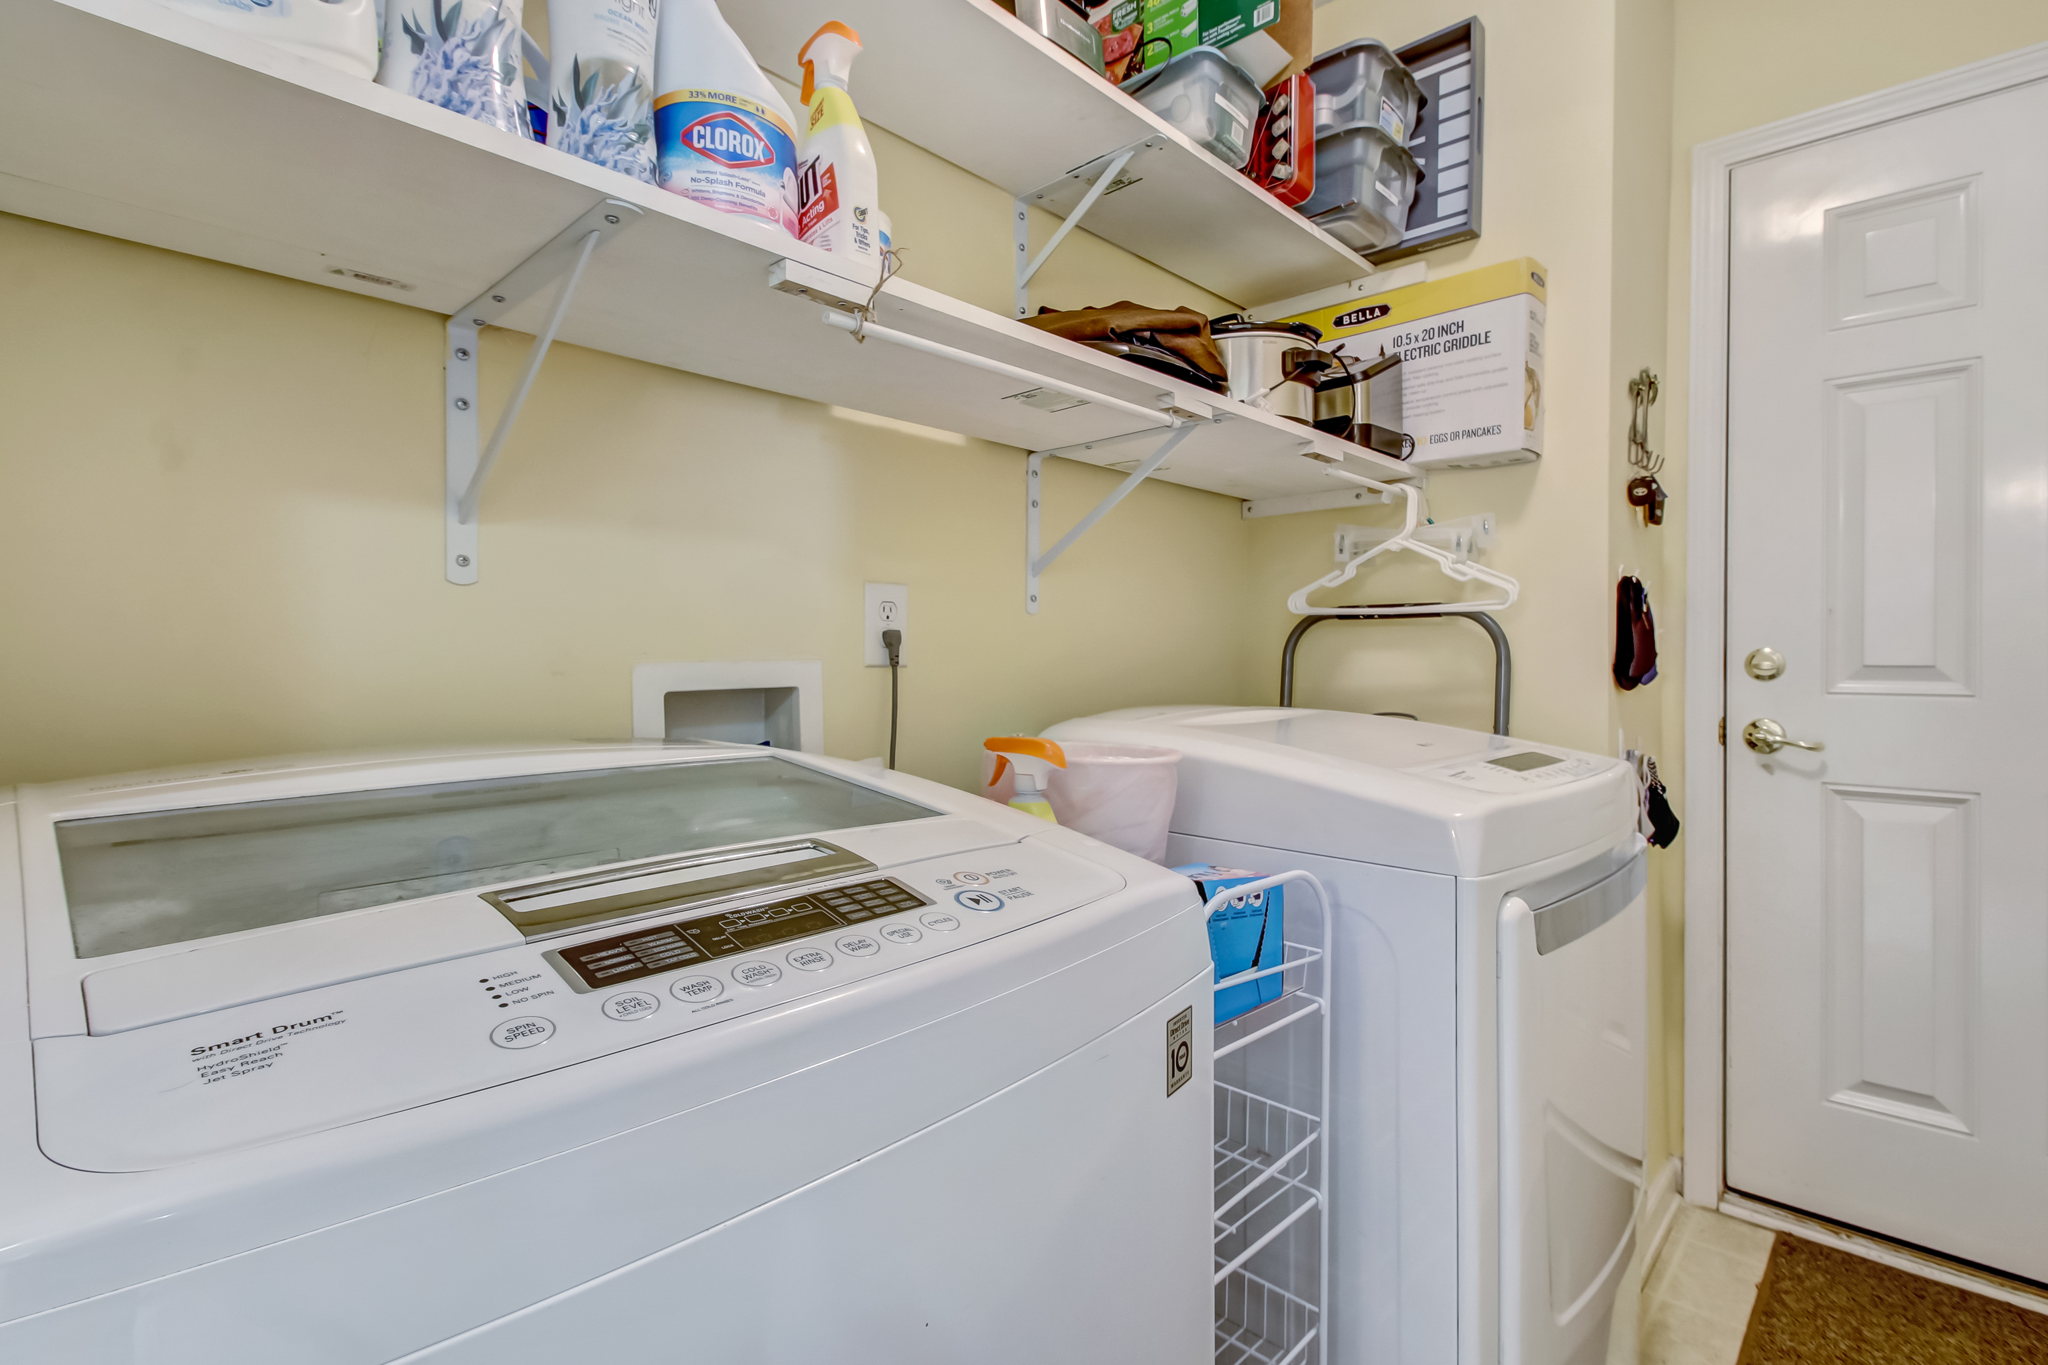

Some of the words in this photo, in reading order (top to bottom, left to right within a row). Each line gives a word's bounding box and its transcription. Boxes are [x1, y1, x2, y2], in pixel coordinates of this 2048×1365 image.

[1147, 22, 1153, 34] 3
[707, 91, 737, 104] MORE
[692, 126, 766, 162] CLOROX
[690, 176, 734, 188] No-Splash
[735, 181, 766, 198] Formula
[802, 200, 825, 226] Acting
[1342, 307, 1381, 325] BELLA
[1393, 333, 1411, 348] 10.5
[1414, 334, 1420, 344] x
[1421, 328, 1435, 342] 20
[1437, 320, 1464, 338] INCH
[1396, 342, 1441, 362] LECTRIC
[1444, 330, 1492, 353] GRIDDLE
[1429, 432, 1449, 445] EGGS
[1450, 431, 1461, 442] OR
[1461, 424, 1502, 440] PANCAKES
[998, 886, 1024, 896] START
[1007, 892, 1035, 900] PAUSE
[928, 917, 954, 926] CYCLES
[887, 928, 914, 937] SPECIAL
[843, 939, 866, 948] DELAY
[848, 943, 873, 953] WASH
[793, 952, 822, 962] EXTRA
[800, 957, 827, 967] RINSE
[493, 971, 518, 980] HIGH
[742, 965, 767, 975] COLD
[499, 974, 542, 988] MEDIUM
[680, 980, 710, 992] WASH
[505, 986, 529, 996] LOW
[530, 990, 555, 1000] SPIN
[686, 985, 713, 997] TEMP
[615, 997, 642, 1007] SOIL
[616, 1000, 652, 1014] LEVEL
[506, 1022, 536, 1034] SPIN
[192, 1053, 217, 1062] with
[220, 1043, 252, 1055] Direct
[256, 1036, 284, 1046] Drive
[287, 1019, 347, 1036] Technology
[504, 1026, 546, 1043] SPEED
[190, 1032, 263, 1056] Smart
[200, 1066, 235, 1078] Easy
[240, 1052, 283, 1068] Reach
[1171, 1041, 1189, 1079] 10
[203, 1075, 226, 1085] Jet
[231, 1062, 274, 1077] Spray
